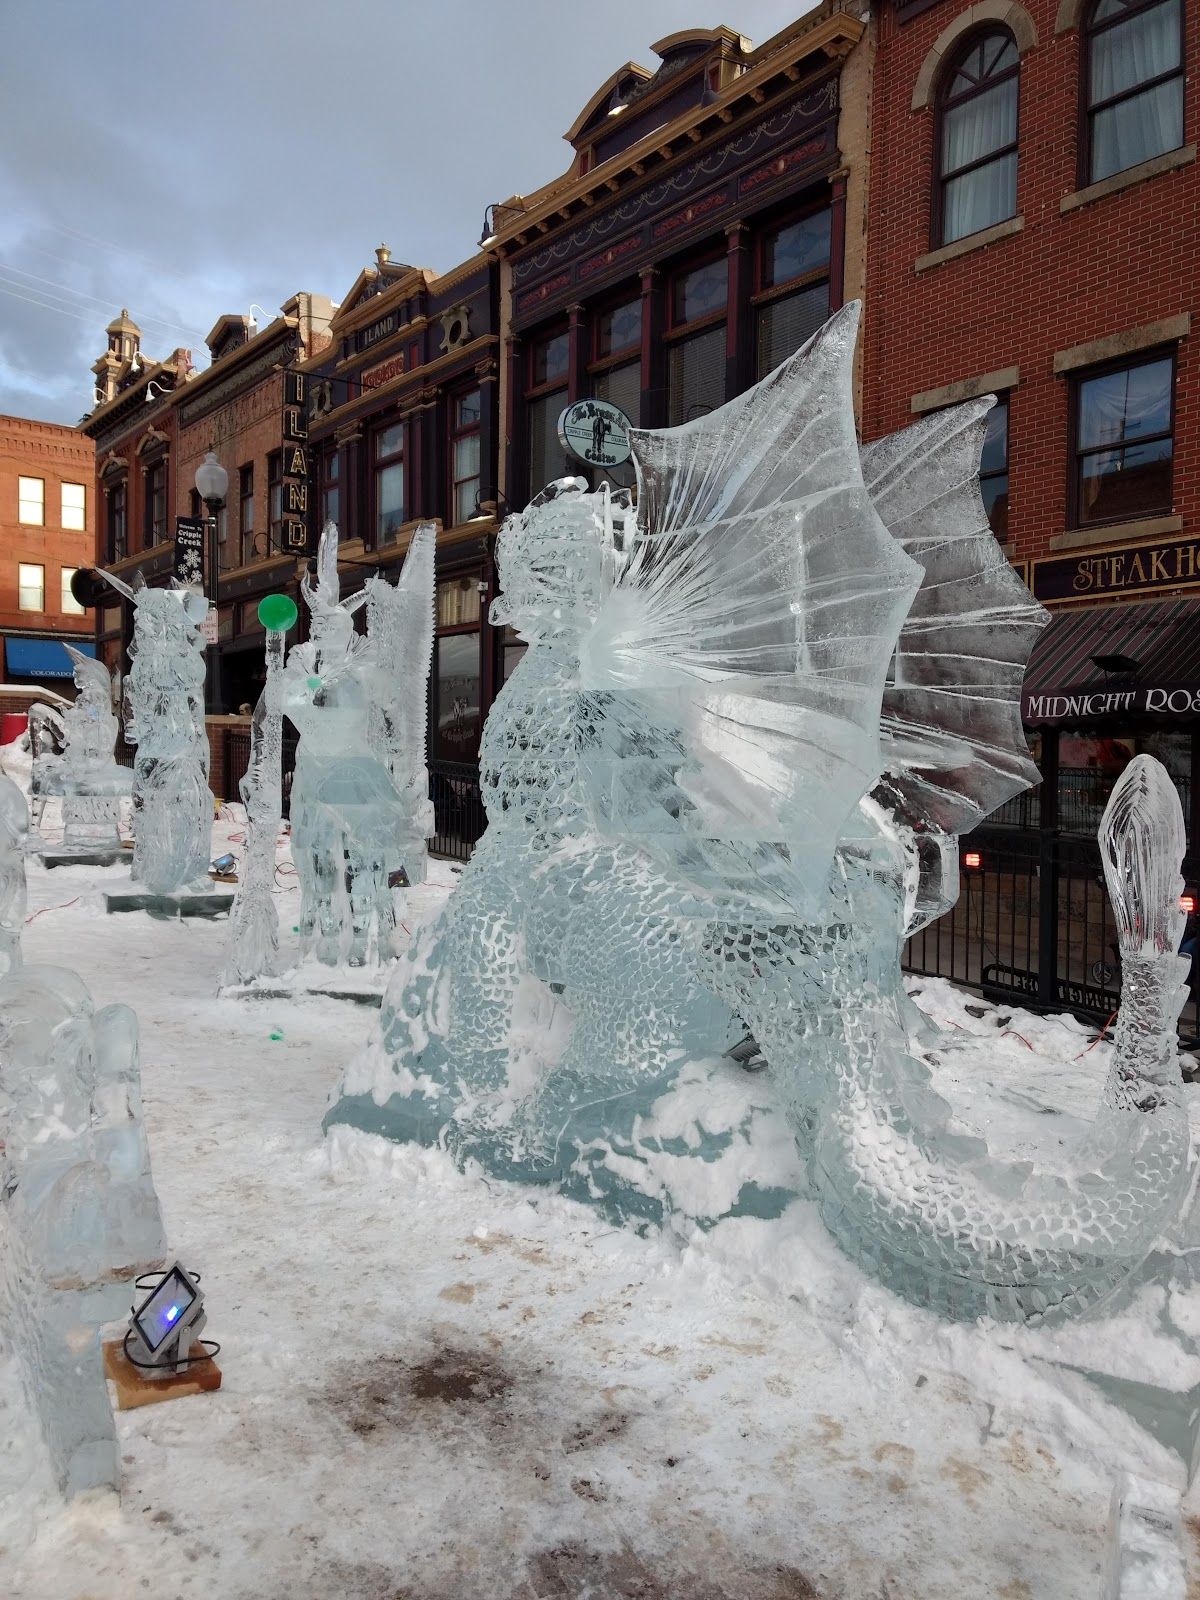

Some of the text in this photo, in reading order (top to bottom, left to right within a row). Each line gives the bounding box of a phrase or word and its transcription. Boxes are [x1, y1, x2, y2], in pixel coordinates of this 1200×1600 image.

[364, 316, 394, 345] ILAND
[288, 374, 308, 547] ILAND
[584, 448, 617, 464] Casino
[177, 536, 202, 547] Creek
[178, 529, 202, 539] Cripple
[1072, 543, 1200, 591] STEAKH
[1026, 690, 1136, 719] MIDNIGHT
